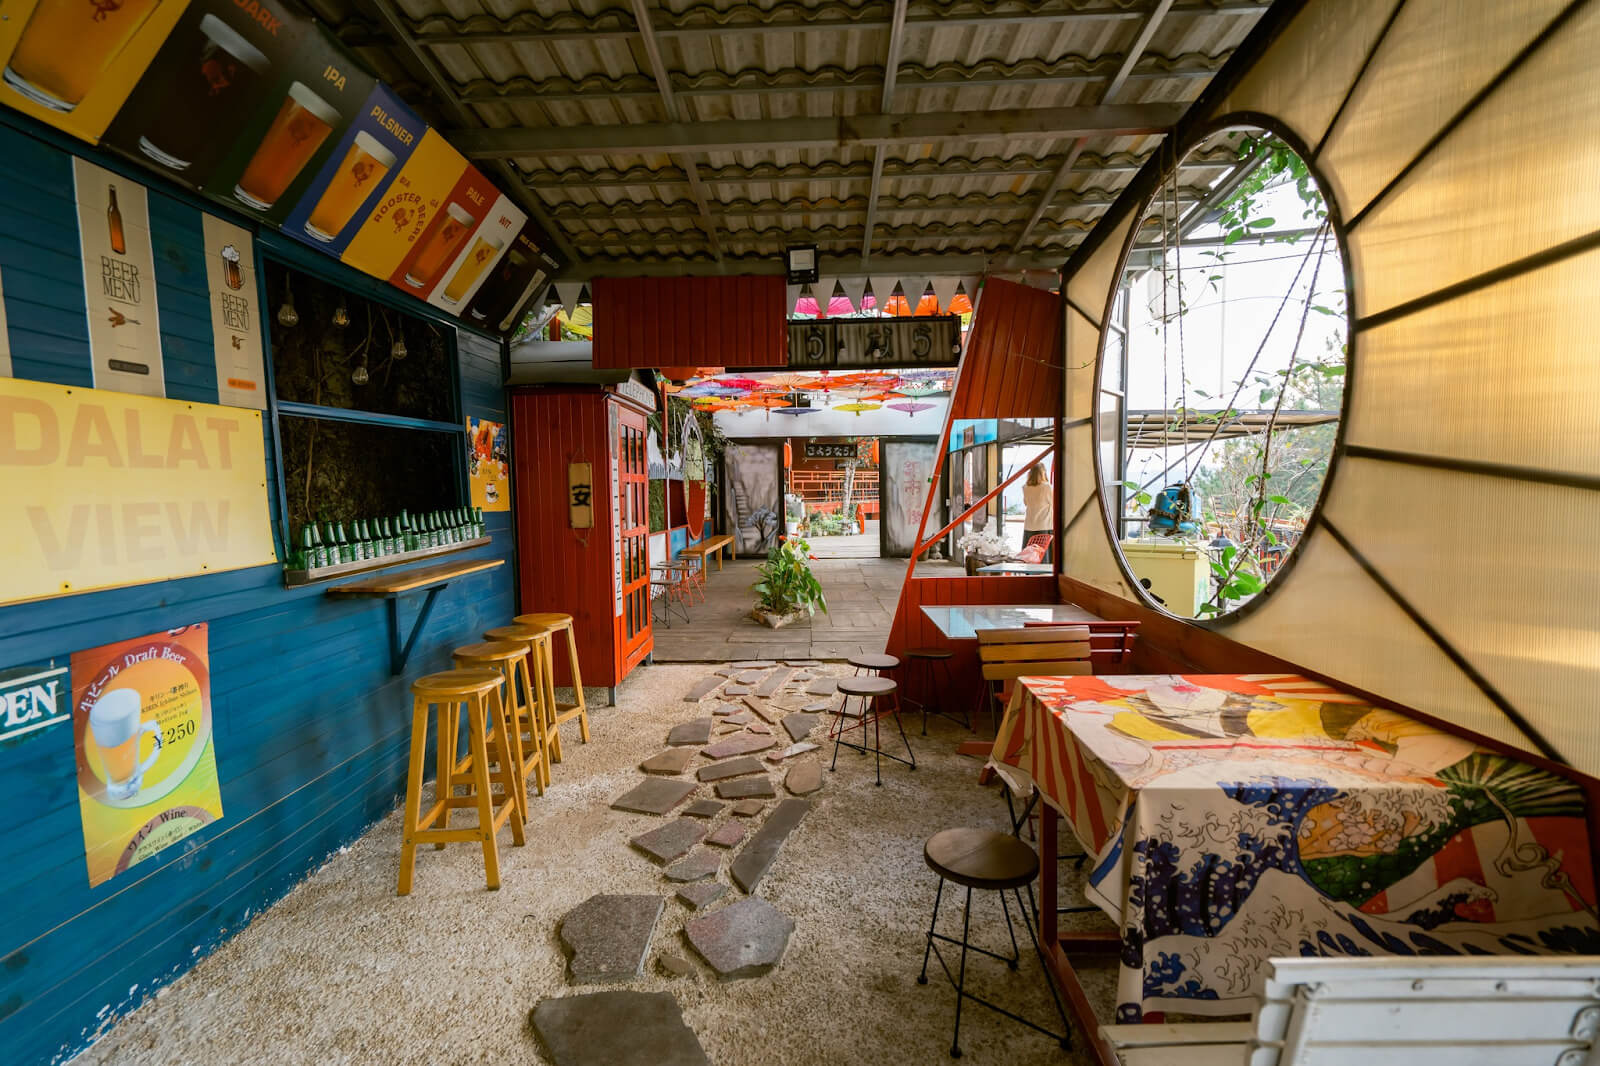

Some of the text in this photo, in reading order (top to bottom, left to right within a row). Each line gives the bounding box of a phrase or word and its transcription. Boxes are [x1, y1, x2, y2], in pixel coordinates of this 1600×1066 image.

[323, 65, 346, 91] IPA
[370, 105, 414, 146] PILSNER
[465, 186, 486, 207] PALE
[374, 192, 427, 243] ROOSTER BEERS
[101, 256, 140, 282] BEER
[102, 276, 142, 304] MENU
[221, 292, 249, 314] BEER
[223, 309, 249, 331] MENU
[0, 395, 240, 470] DALAT
[571, 483, 591, 507] 安
[26, 501, 231, 571] VIEW
[123, 647, 157, 668] Draft
[161, 646, 187, 665] Beer
[159, 809, 186, 823] Wine
